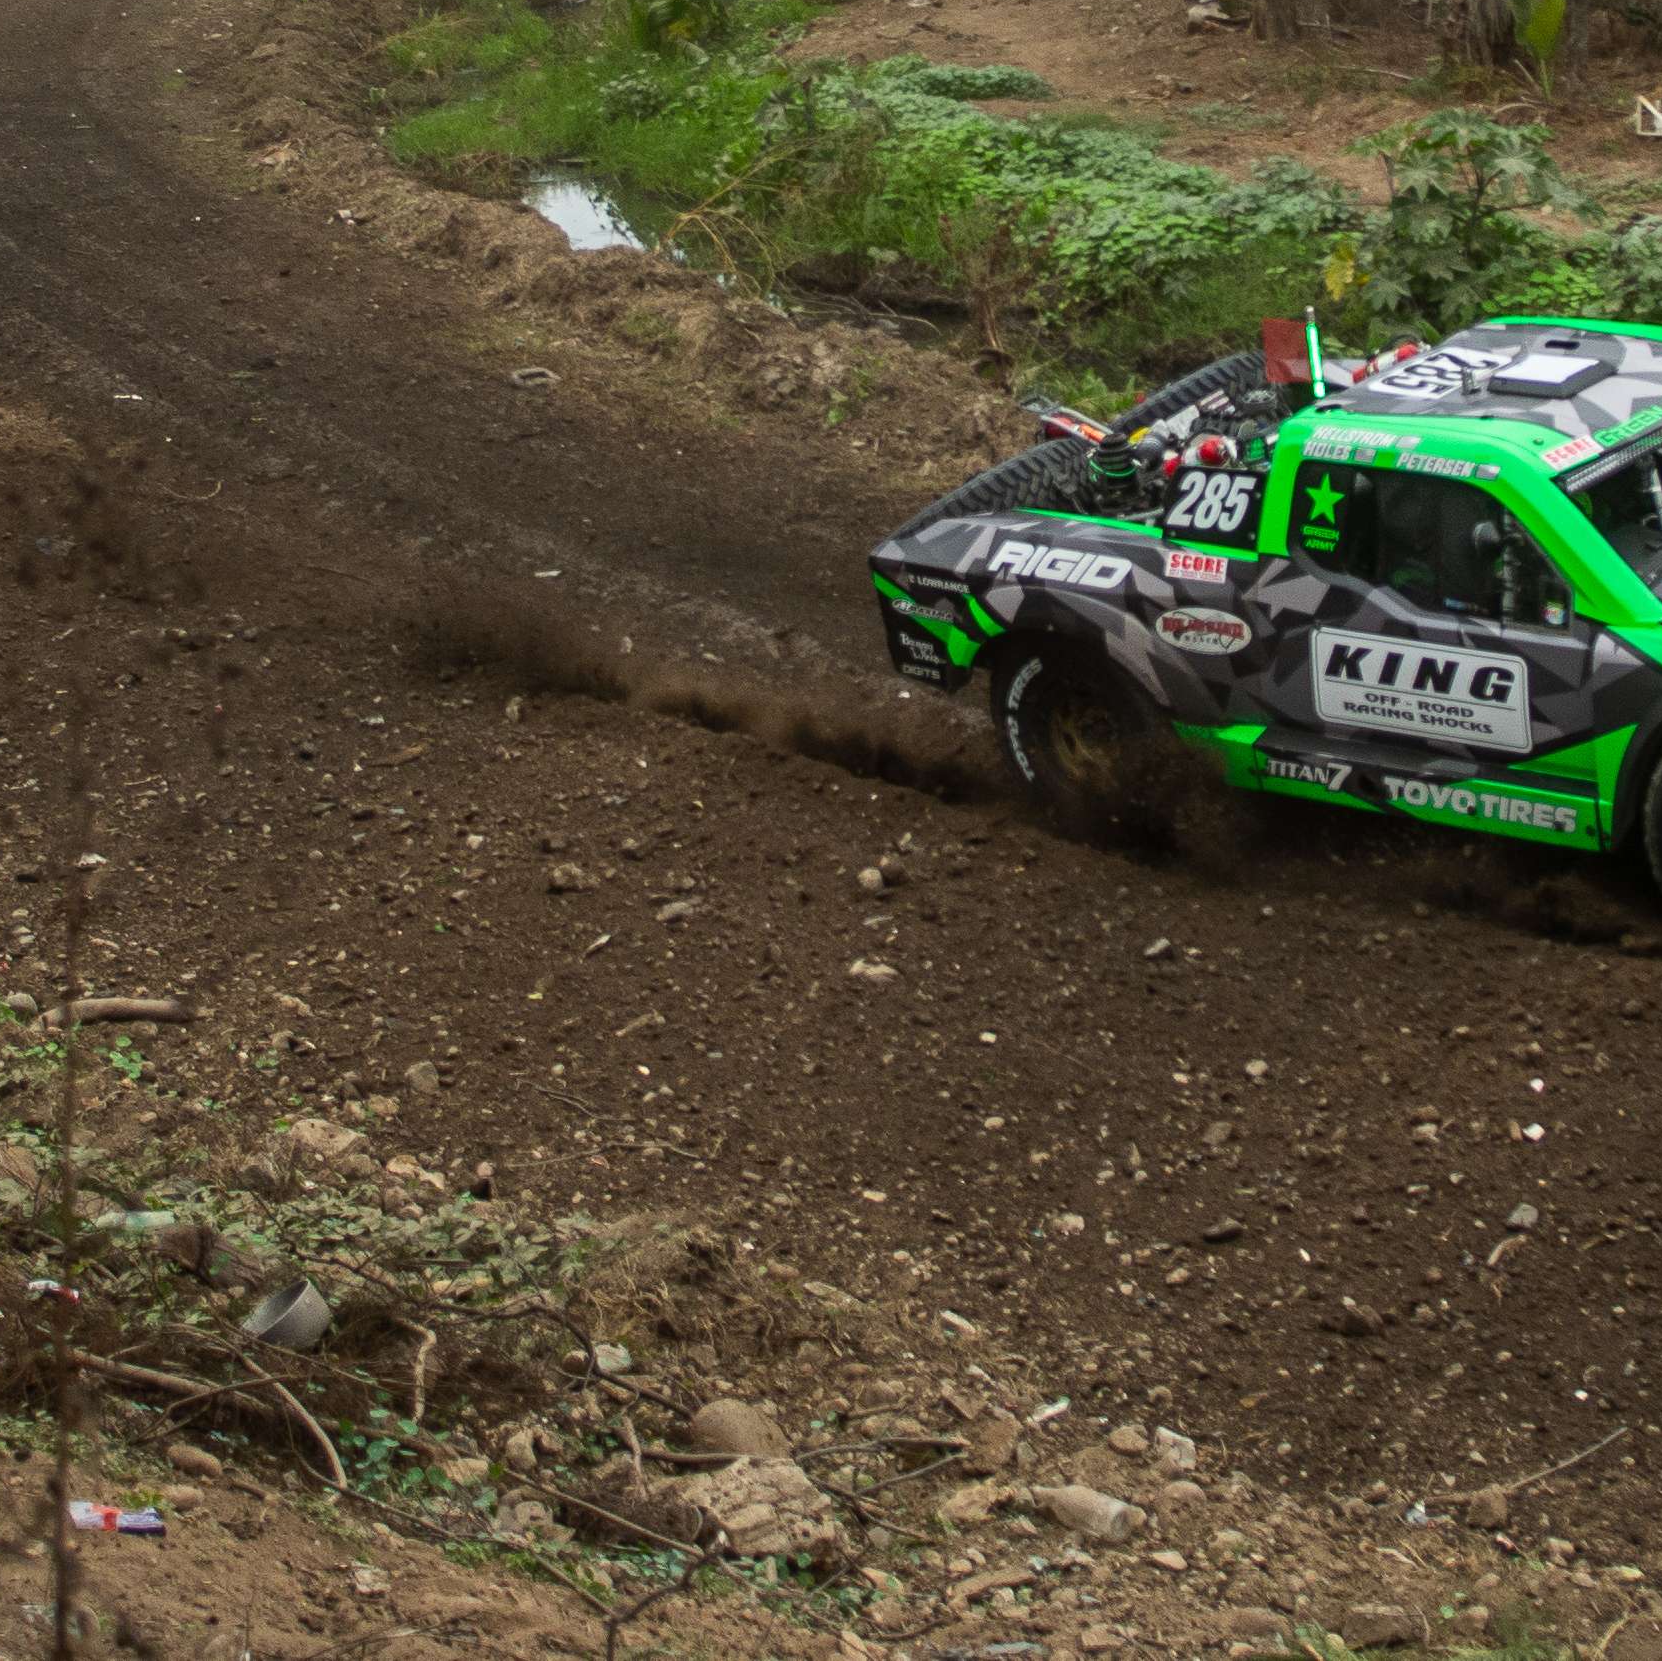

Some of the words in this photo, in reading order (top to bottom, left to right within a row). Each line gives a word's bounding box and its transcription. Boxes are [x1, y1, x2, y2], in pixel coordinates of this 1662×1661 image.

[1314, 424, 1397, 448] HELLSTROM
[1396, 452, 1476, 478] PETERSEN
[1166, 471, 1257, 533] 285
[1302, 524, 1340, 543] GREEN
[1304, 538, 1337, 553] ARMY
[988, 540, 1134, 590] RIGID
[1170, 552, 1226, 574] SCORE
[1324, 643, 1516, 704] KING
[1343, 701, 1415, 722] RACING
[1419, 713, 1495, 735] SHOCKS
[1365, 692, 1402, 707] OFF
[1417, 700, 1475, 719] ROAD
[1382, 775, 1476, 816] TOYO
[1479, 793, 1578, 835] TIRES
